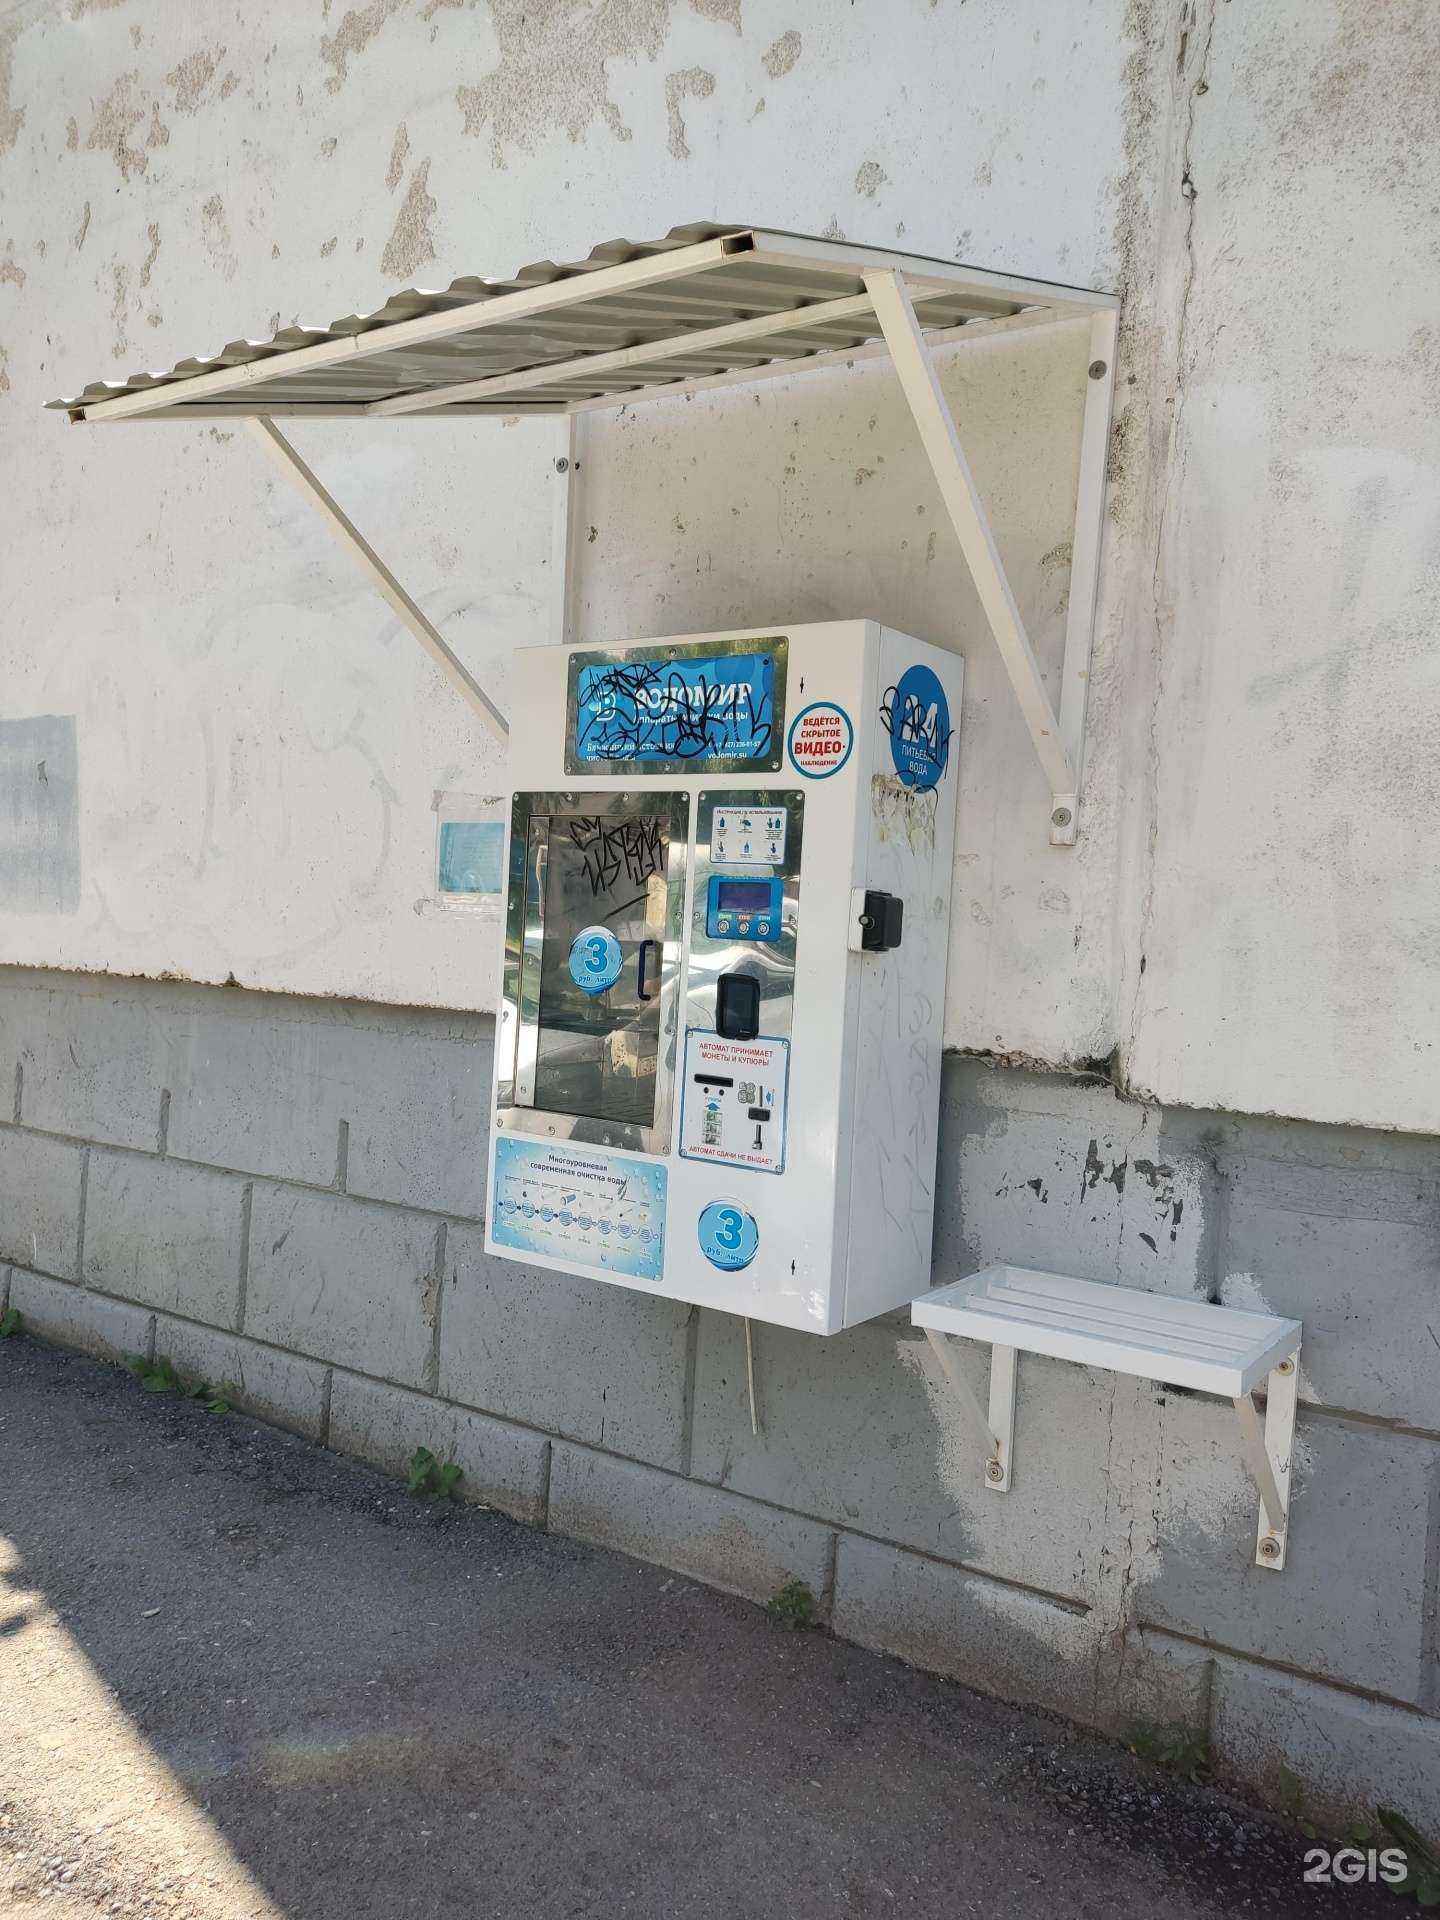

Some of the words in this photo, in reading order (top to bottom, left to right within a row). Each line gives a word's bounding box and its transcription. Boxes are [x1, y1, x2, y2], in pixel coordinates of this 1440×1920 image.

[803, 716, 840, 727] ВЕДЁТСЯ
[801, 729, 841, 738] СКРЫТОЕ
[908, 760, 929, 777] ВОДА
[583, 935, 608, 974] 3
[699, 1042, 730, 1053] АВТОМАТ
[731, 1046, 774, 1059] ПРИНИМАЕТ
[701, 1051, 731, 1063] МОНЕТЫ
[731, 1055, 737, 1063] И
[738, 1056, 770, 1067] КУПЮРЫ
[689, 1145, 716, 1157] АВТОМАТ
[737, 1152, 746, 1161] НЕ
[548, 1154, 609, 1172] Многоуровневая
[530, 1161, 576, 1177] современная
[576, 1169, 607, 1183] очистка
[715, 1208, 744, 1251] 3
